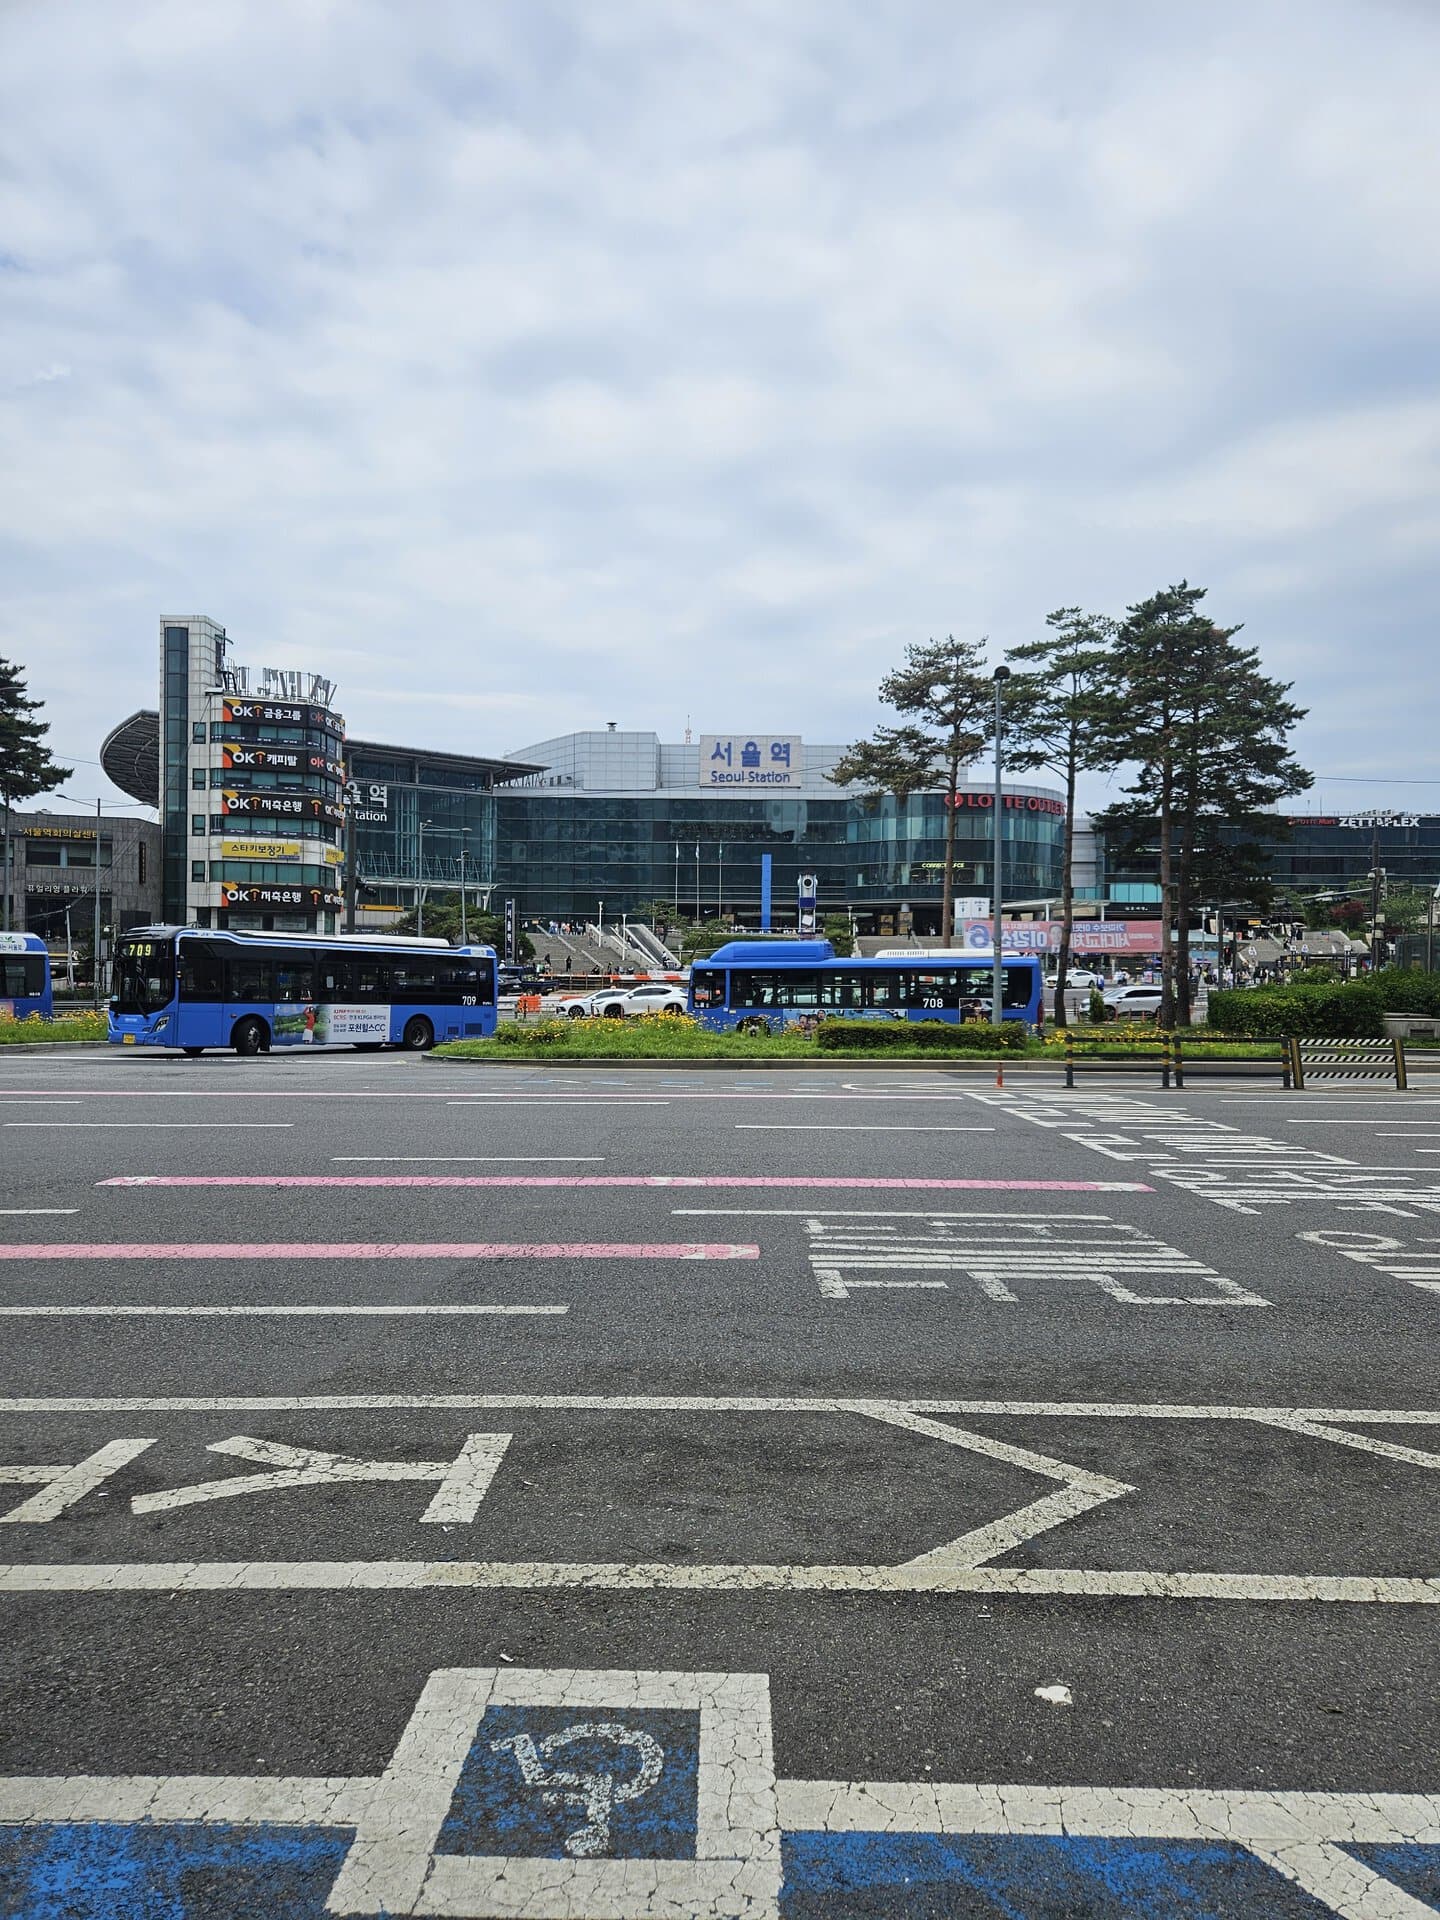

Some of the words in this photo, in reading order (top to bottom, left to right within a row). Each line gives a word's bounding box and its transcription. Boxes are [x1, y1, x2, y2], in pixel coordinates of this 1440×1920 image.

[232, 705, 253, 717] OK
[263, 707, 302, 721] 금융그룹
[232, 752, 255, 764] OK
[266, 753, 298, 767] 캐피탈
[711, 741, 791, 768] 서울역
[711, 770, 745, 783] Seoul
[748, 770, 791, 783] Station
[343, 781, 388, 808] 울역
[227, 798, 251, 809] OK
[261, 799, 302, 812] 저축은행
[968, 794, 1025, 809] LOTE
[1027, 797, 1067, 816] OUTLETS
[349, 810, 388, 822] tation
[1338, 817, 1420, 827] ZETTAPLEX
[226, 890, 250, 901] OK
[260, 890, 302, 903] 저축은행
[129, 944, 152, 956] 709
[462, 996, 477, 1006] 709
[922, 998, 944, 1009] 708
[348, 1023, 386, 1033] 포천힐스CC
